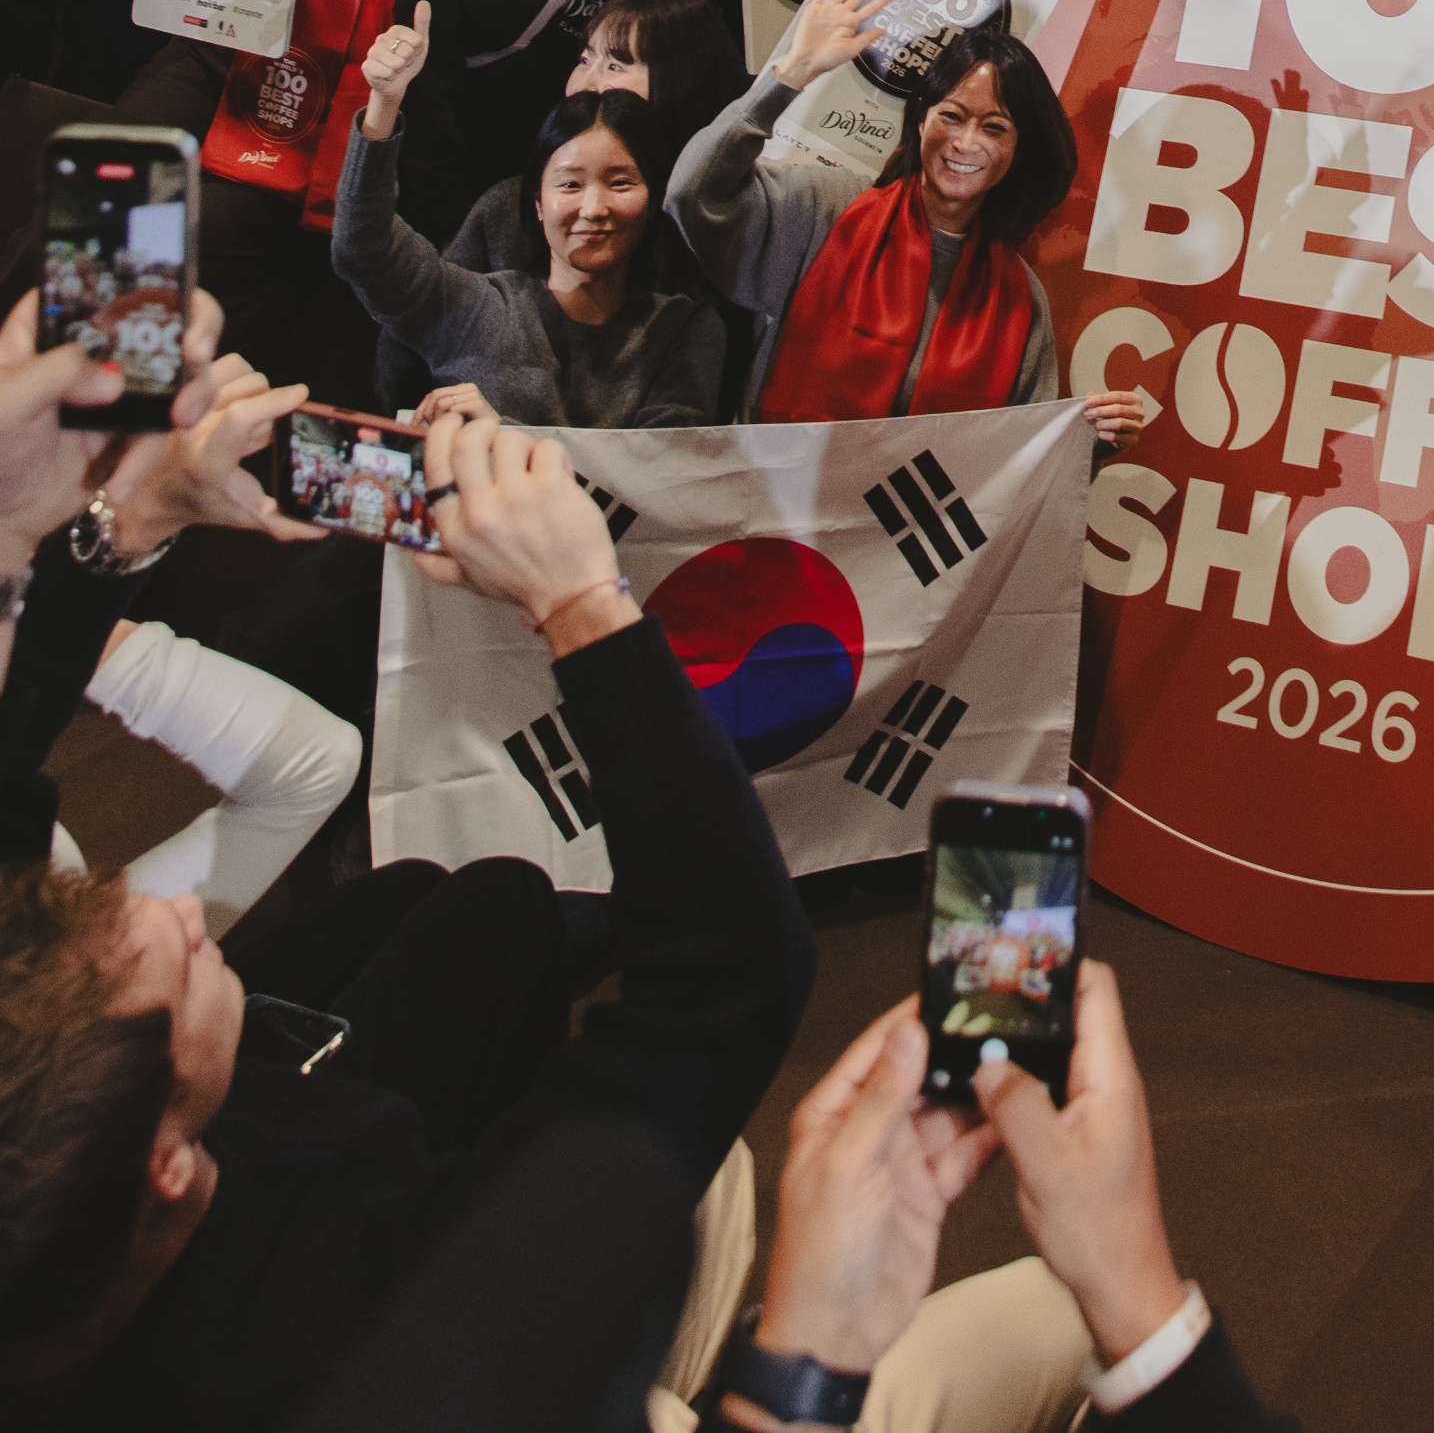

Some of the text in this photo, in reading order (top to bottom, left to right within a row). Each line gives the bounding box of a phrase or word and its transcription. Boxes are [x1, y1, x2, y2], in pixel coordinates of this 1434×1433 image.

[881, 58, 906, 77] 2026
[265, 66, 308, 95] 100
[260, 84, 304, 109] BEST
[257, 99, 299, 120] COFFEE
[257, 109, 294, 128] SHOPS
[819, 110, 895, 140] DaVinci
[1216, 656, 1420, 765] 2026
